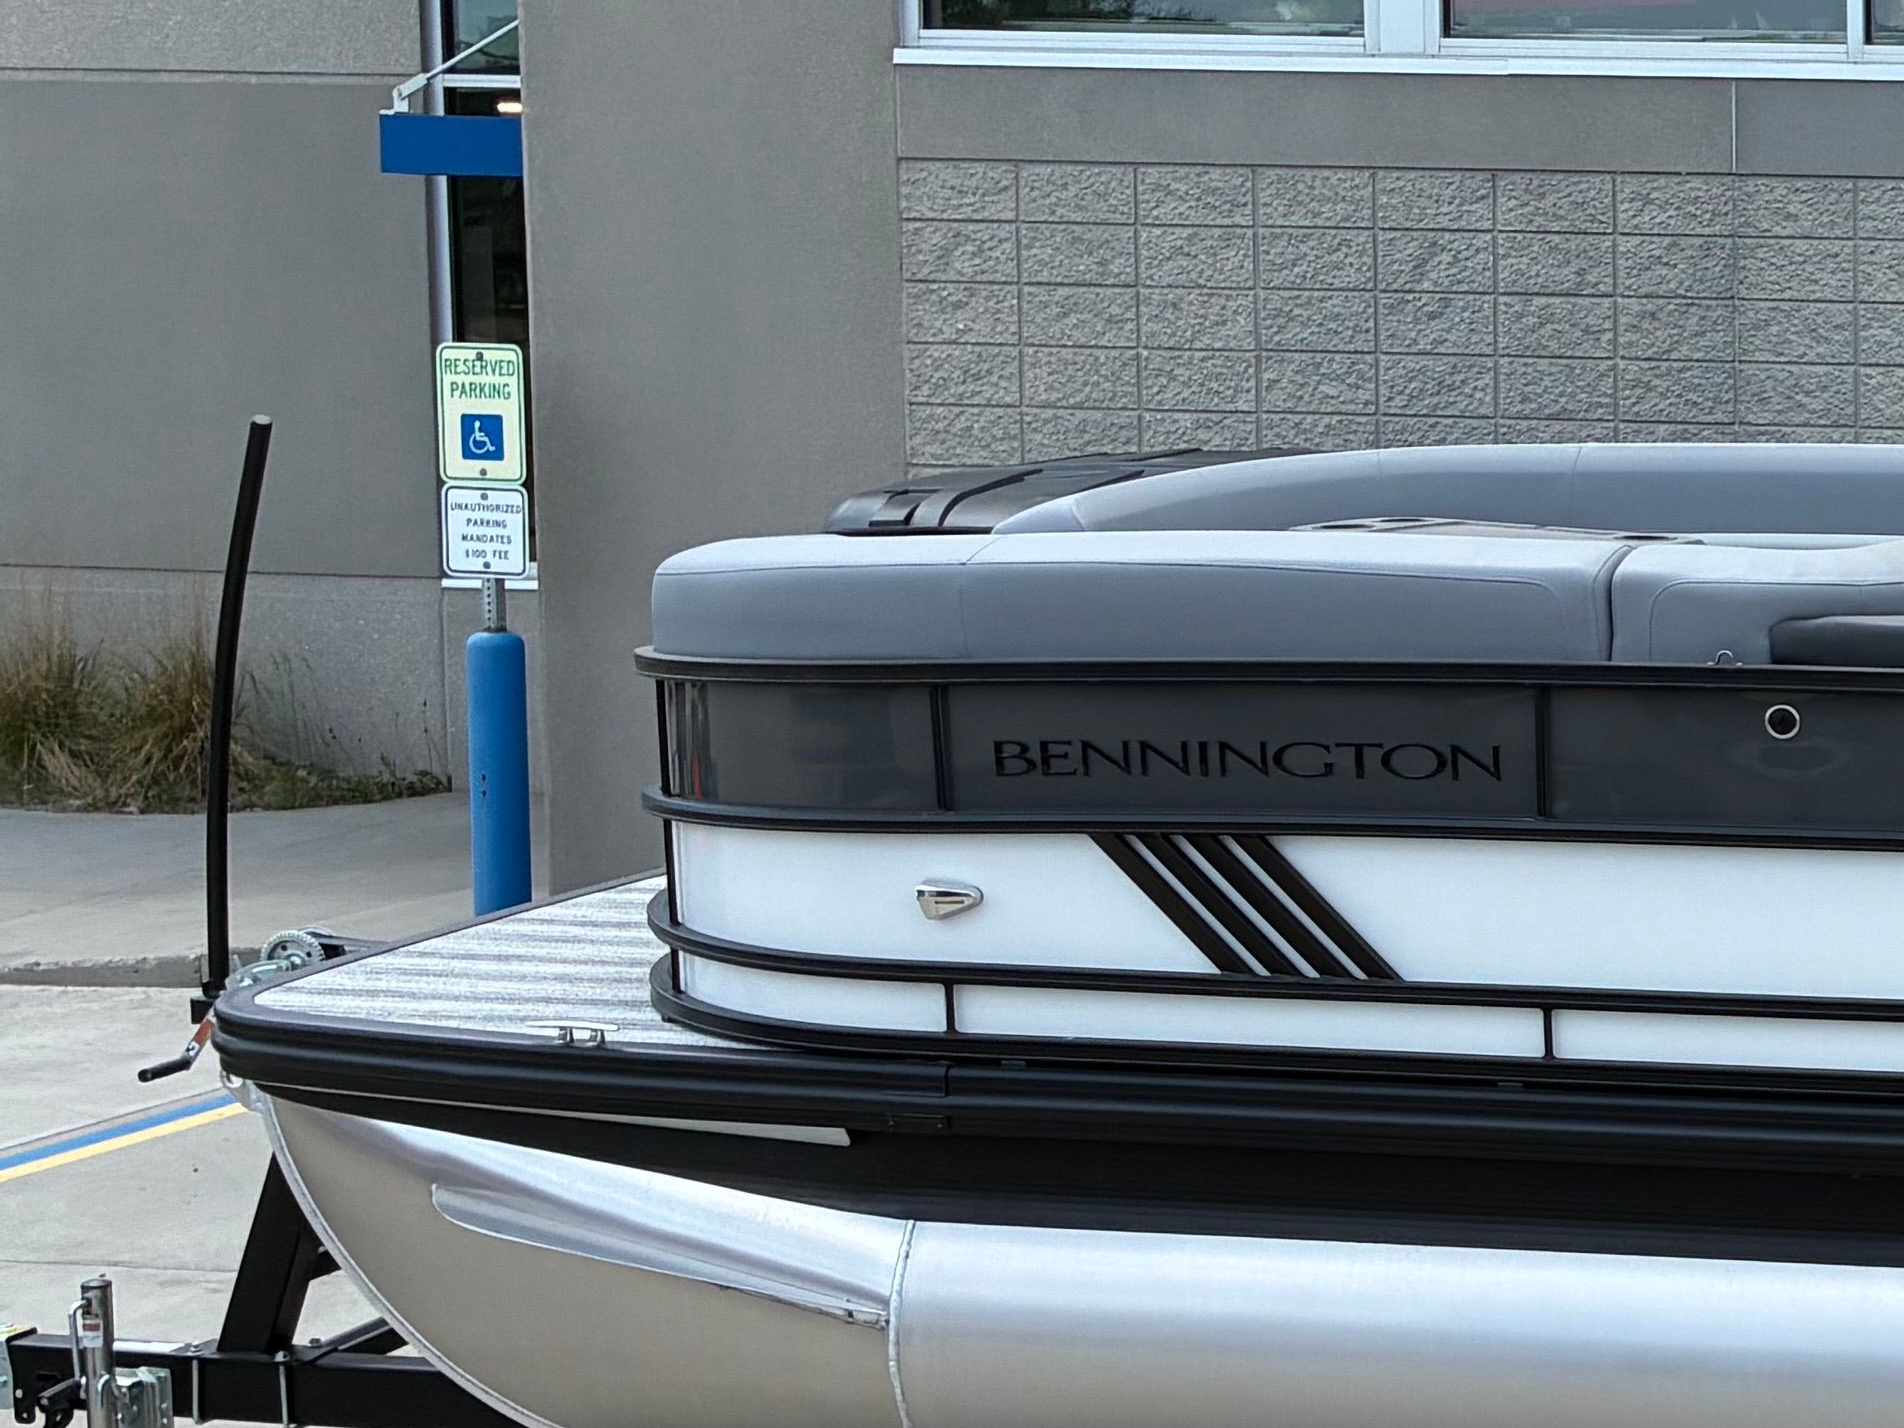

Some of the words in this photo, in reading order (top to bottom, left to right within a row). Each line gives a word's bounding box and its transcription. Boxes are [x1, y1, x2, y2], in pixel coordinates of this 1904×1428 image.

[444, 358, 516, 377] RESERVED
[450, 381, 512, 400] PARKING
[450, 501, 523, 514] UNAUTHORIZED
[466, 517, 508, 529] PARKING
[461, 533, 513, 545] MANDATES
[465, 548, 488, 559] $100
[493, 550, 510, 561] FEE
[993, 739, 1502, 782] BENNINGTON
